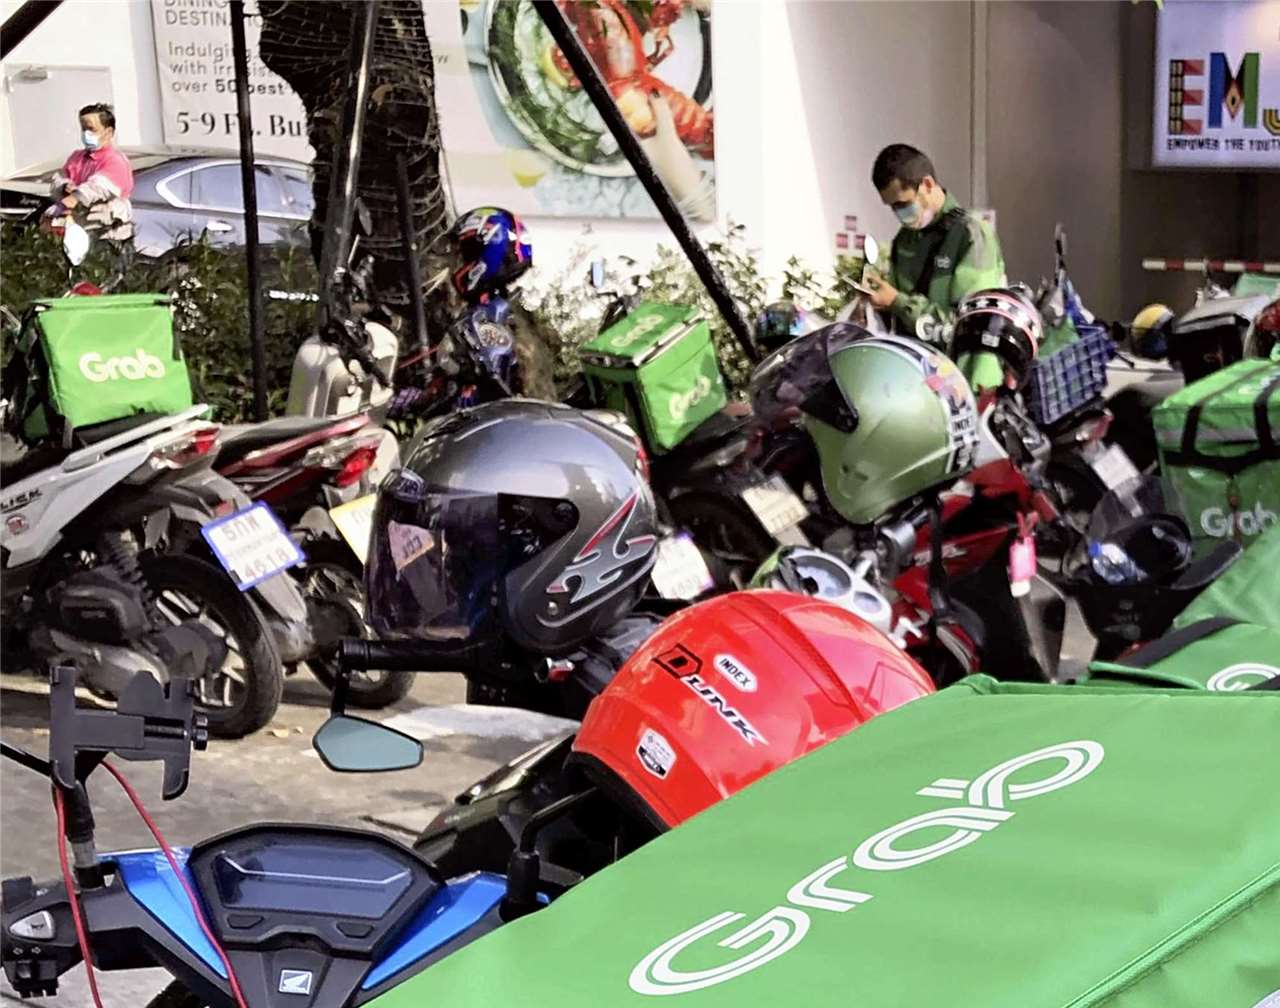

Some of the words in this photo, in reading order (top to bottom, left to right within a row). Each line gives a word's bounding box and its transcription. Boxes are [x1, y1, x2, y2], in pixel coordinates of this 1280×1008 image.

[169, 60, 207, 75] with
[171, 82, 208, 94] over
[176, 112, 216, 135] 5-9
[78, 347, 166, 383] Grab
[719, 657, 752, 688] INDEX
[627, 739, 1105, 996] Grab
